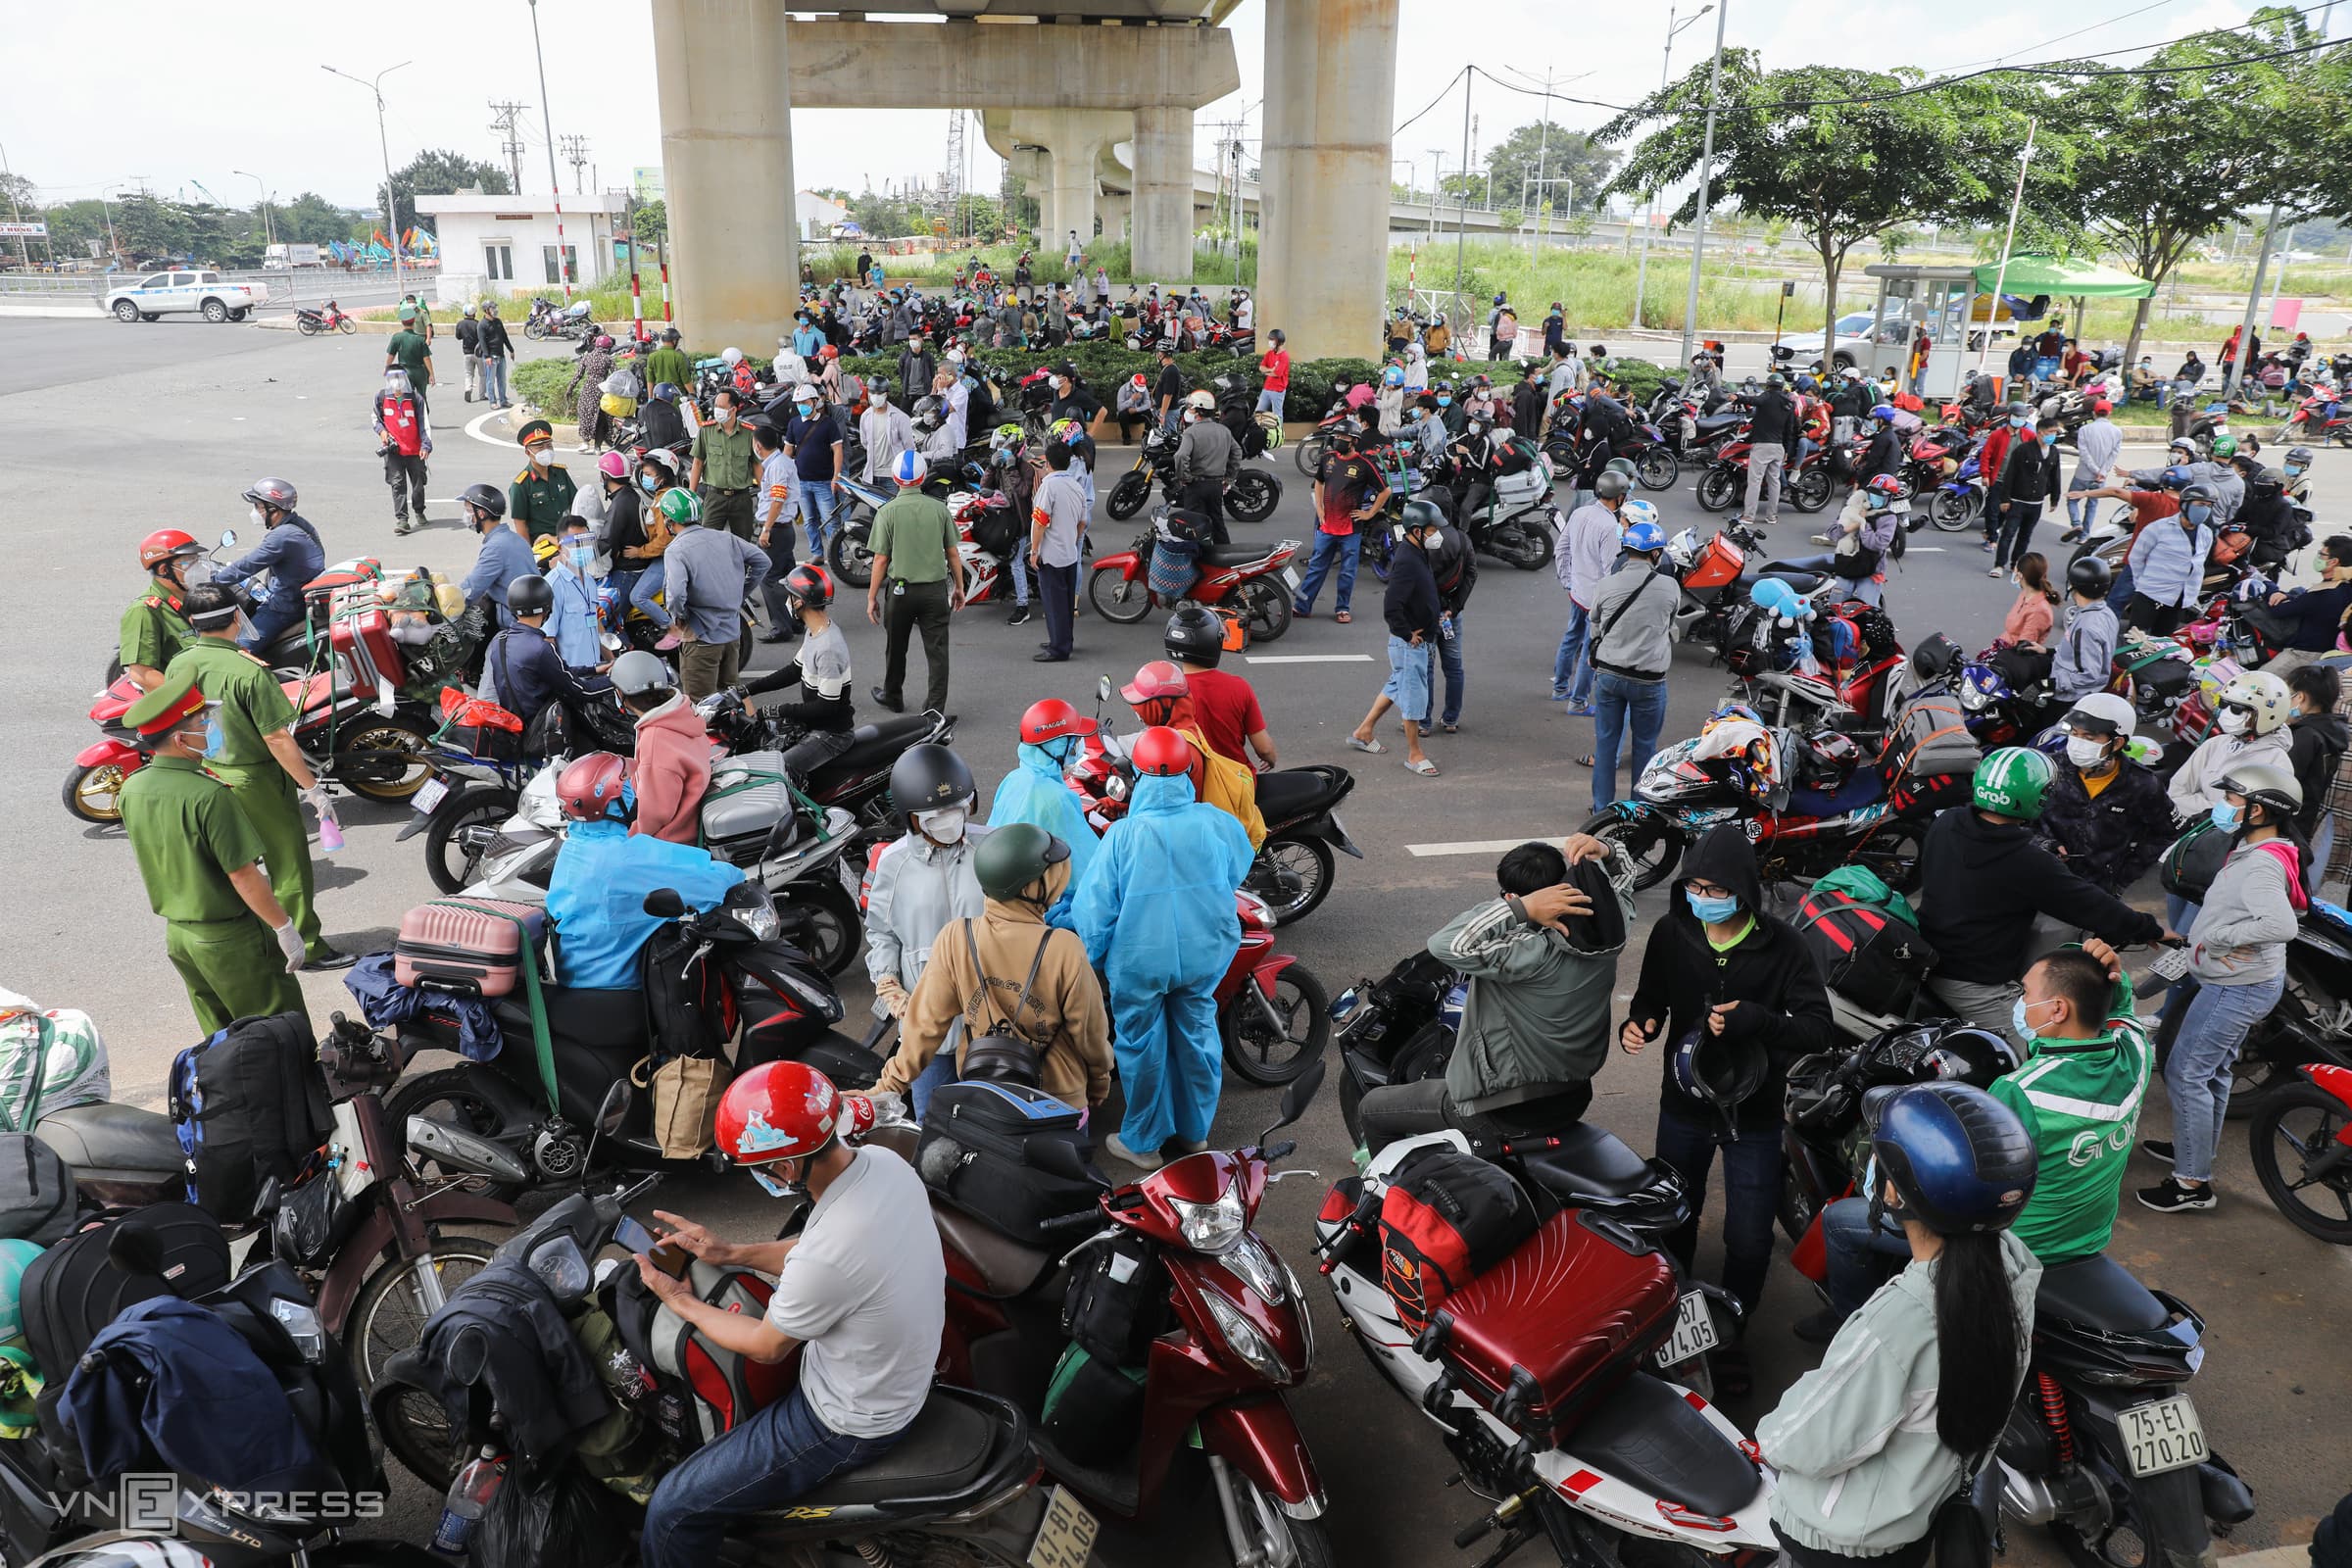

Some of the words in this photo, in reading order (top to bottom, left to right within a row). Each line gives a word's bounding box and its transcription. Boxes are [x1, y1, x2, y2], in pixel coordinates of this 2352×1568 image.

[662, 501, 676, 514] Grab
[1042, 718, 1067, 731] PIAGGIO
[1976, 785, 2011, 806] Grab
[1935, 1049, 1951, 1075] HONDA
[2129, 1402, 2185, 1441] 75-E1
[2132, 1431, 2203, 1472] 270.20
[1036, 1499, 1073, 1566] 47-B1
